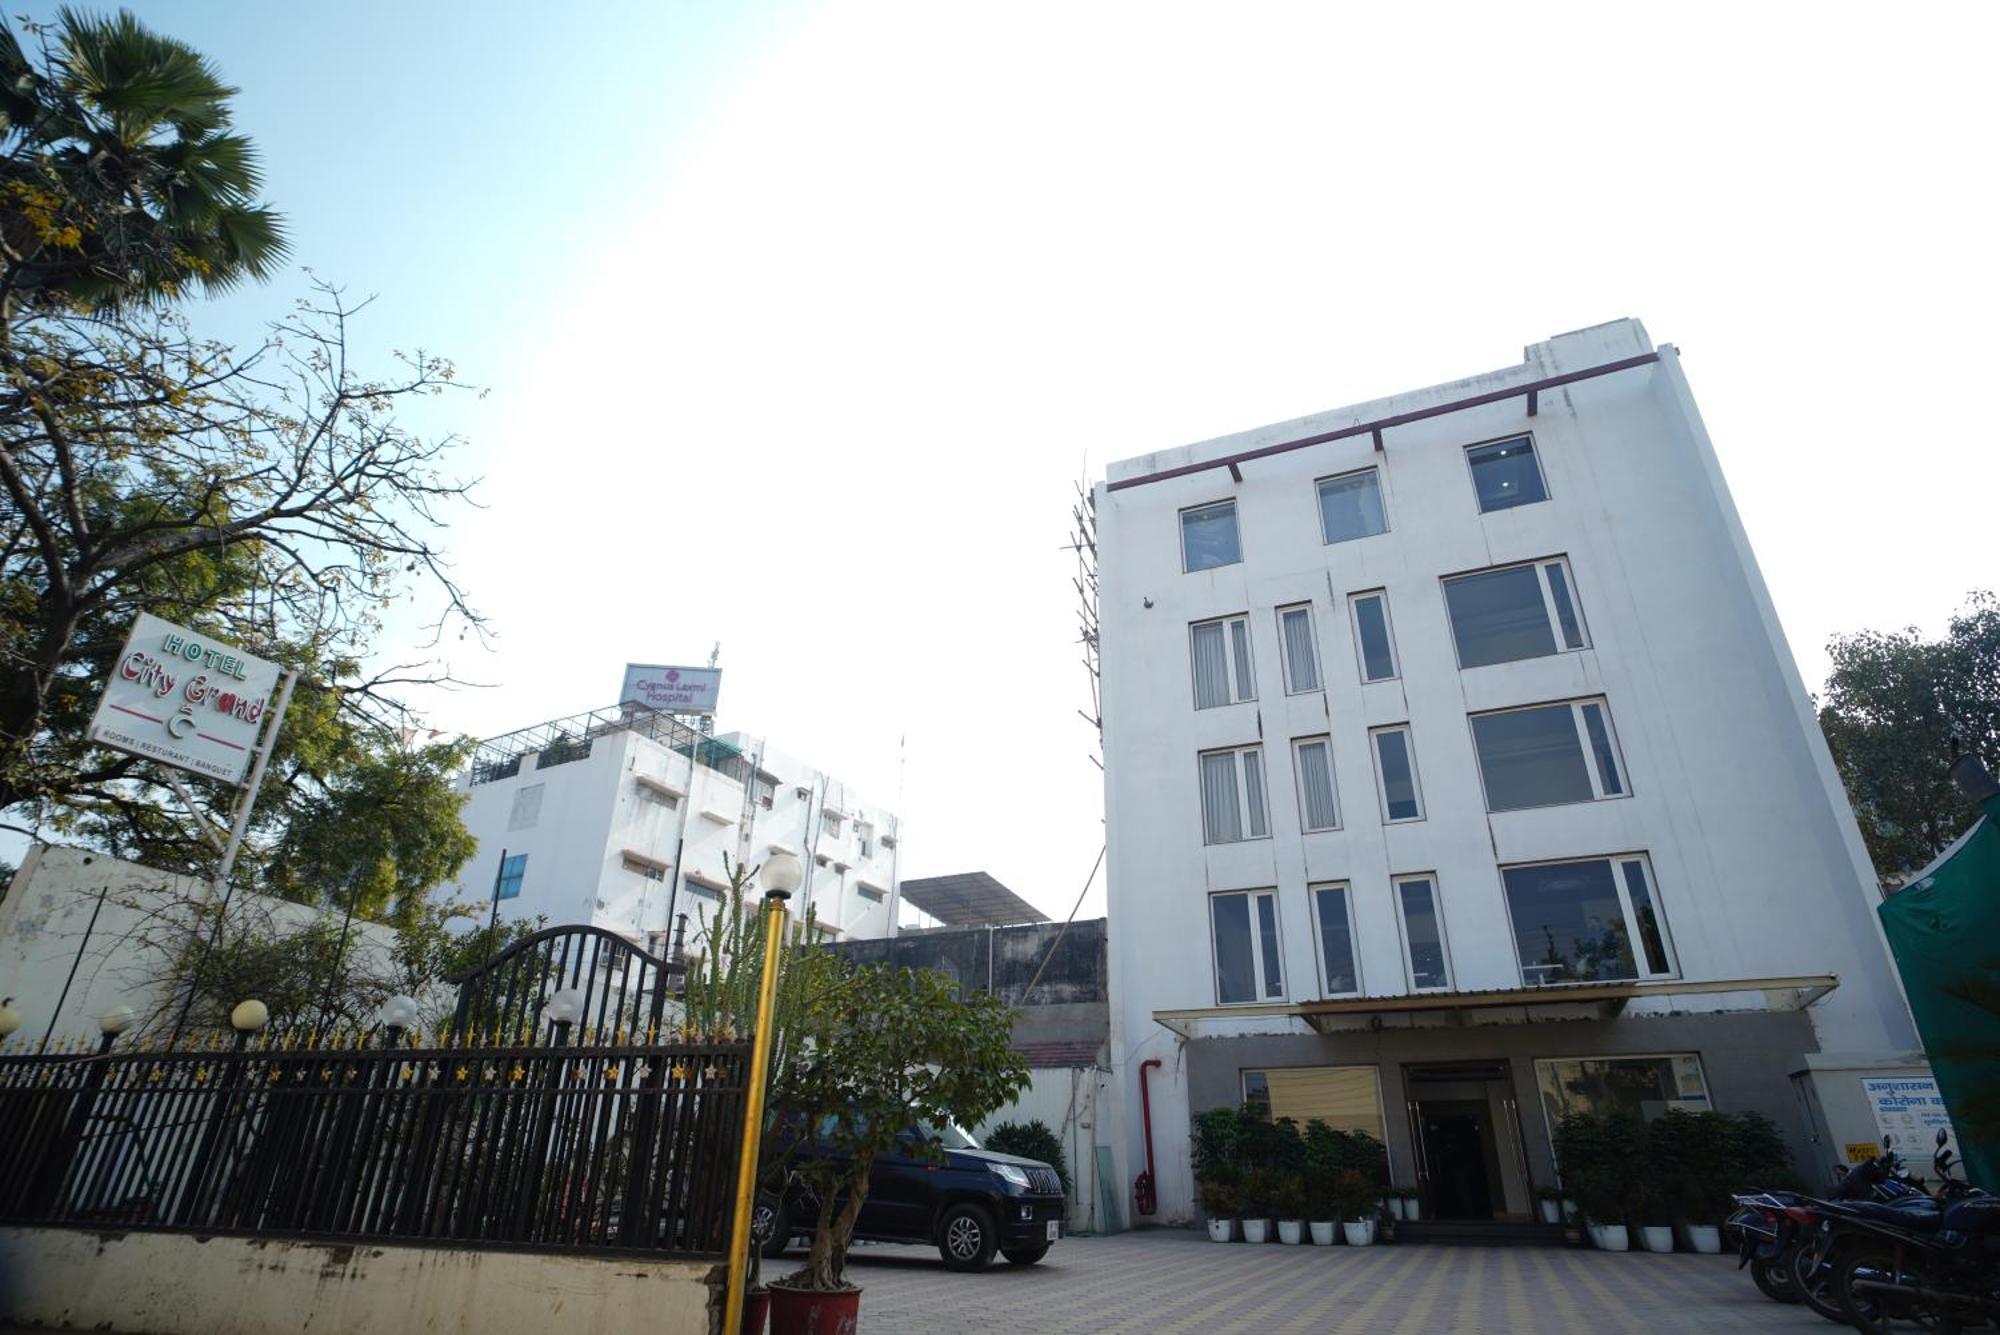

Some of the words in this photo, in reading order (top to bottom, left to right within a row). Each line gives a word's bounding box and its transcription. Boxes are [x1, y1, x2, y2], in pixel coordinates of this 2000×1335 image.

[162, 632, 247, 680] HOTEL
[121, 652, 177, 698] City
[185, 675, 265, 724] Grand
[636, 679, 674, 692] Cygnus
[676, 682, 706, 692] Laxmi
[646, 691, 692, 704] Hospital
[103, 730, 135, 745] ROOMS
[140, 742, 190, 763] RESTURANT
[194, 759, 233, 776] BANQUET
[1877, 1095, 1926, 1105] कोरोना
